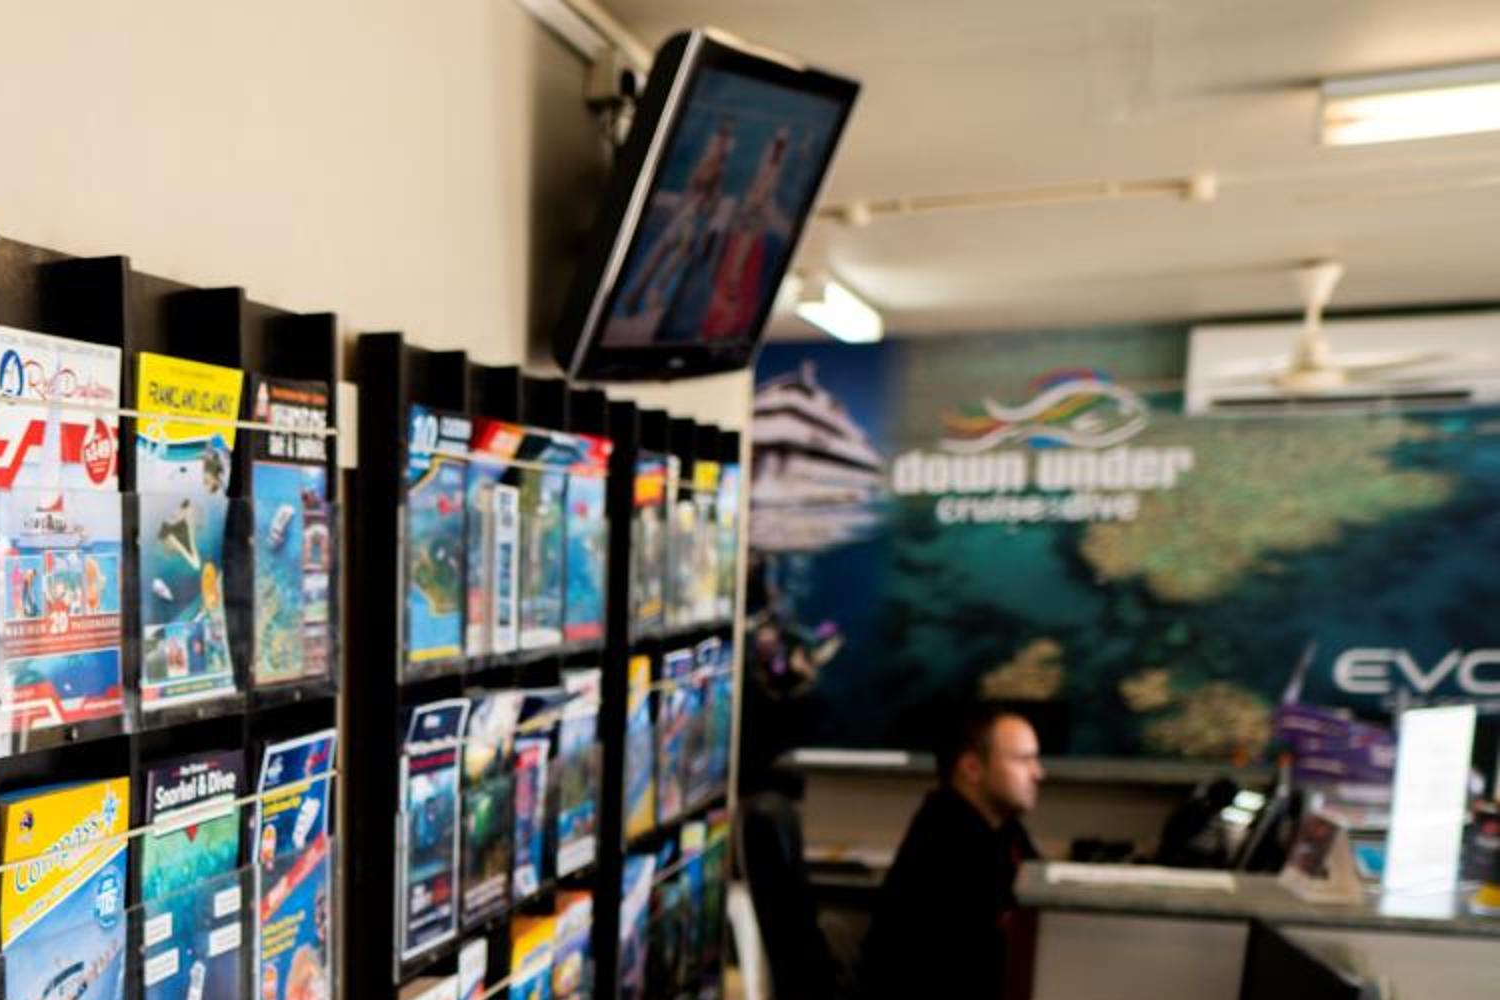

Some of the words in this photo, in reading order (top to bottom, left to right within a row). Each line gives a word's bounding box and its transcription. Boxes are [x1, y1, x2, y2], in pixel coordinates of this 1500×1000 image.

[893, 449, 1028, 495] down
[1036, 446, 1195, 492] under
[154, 776, 197, 811] Snorkel
[207, 769, 237, 794] Dive
